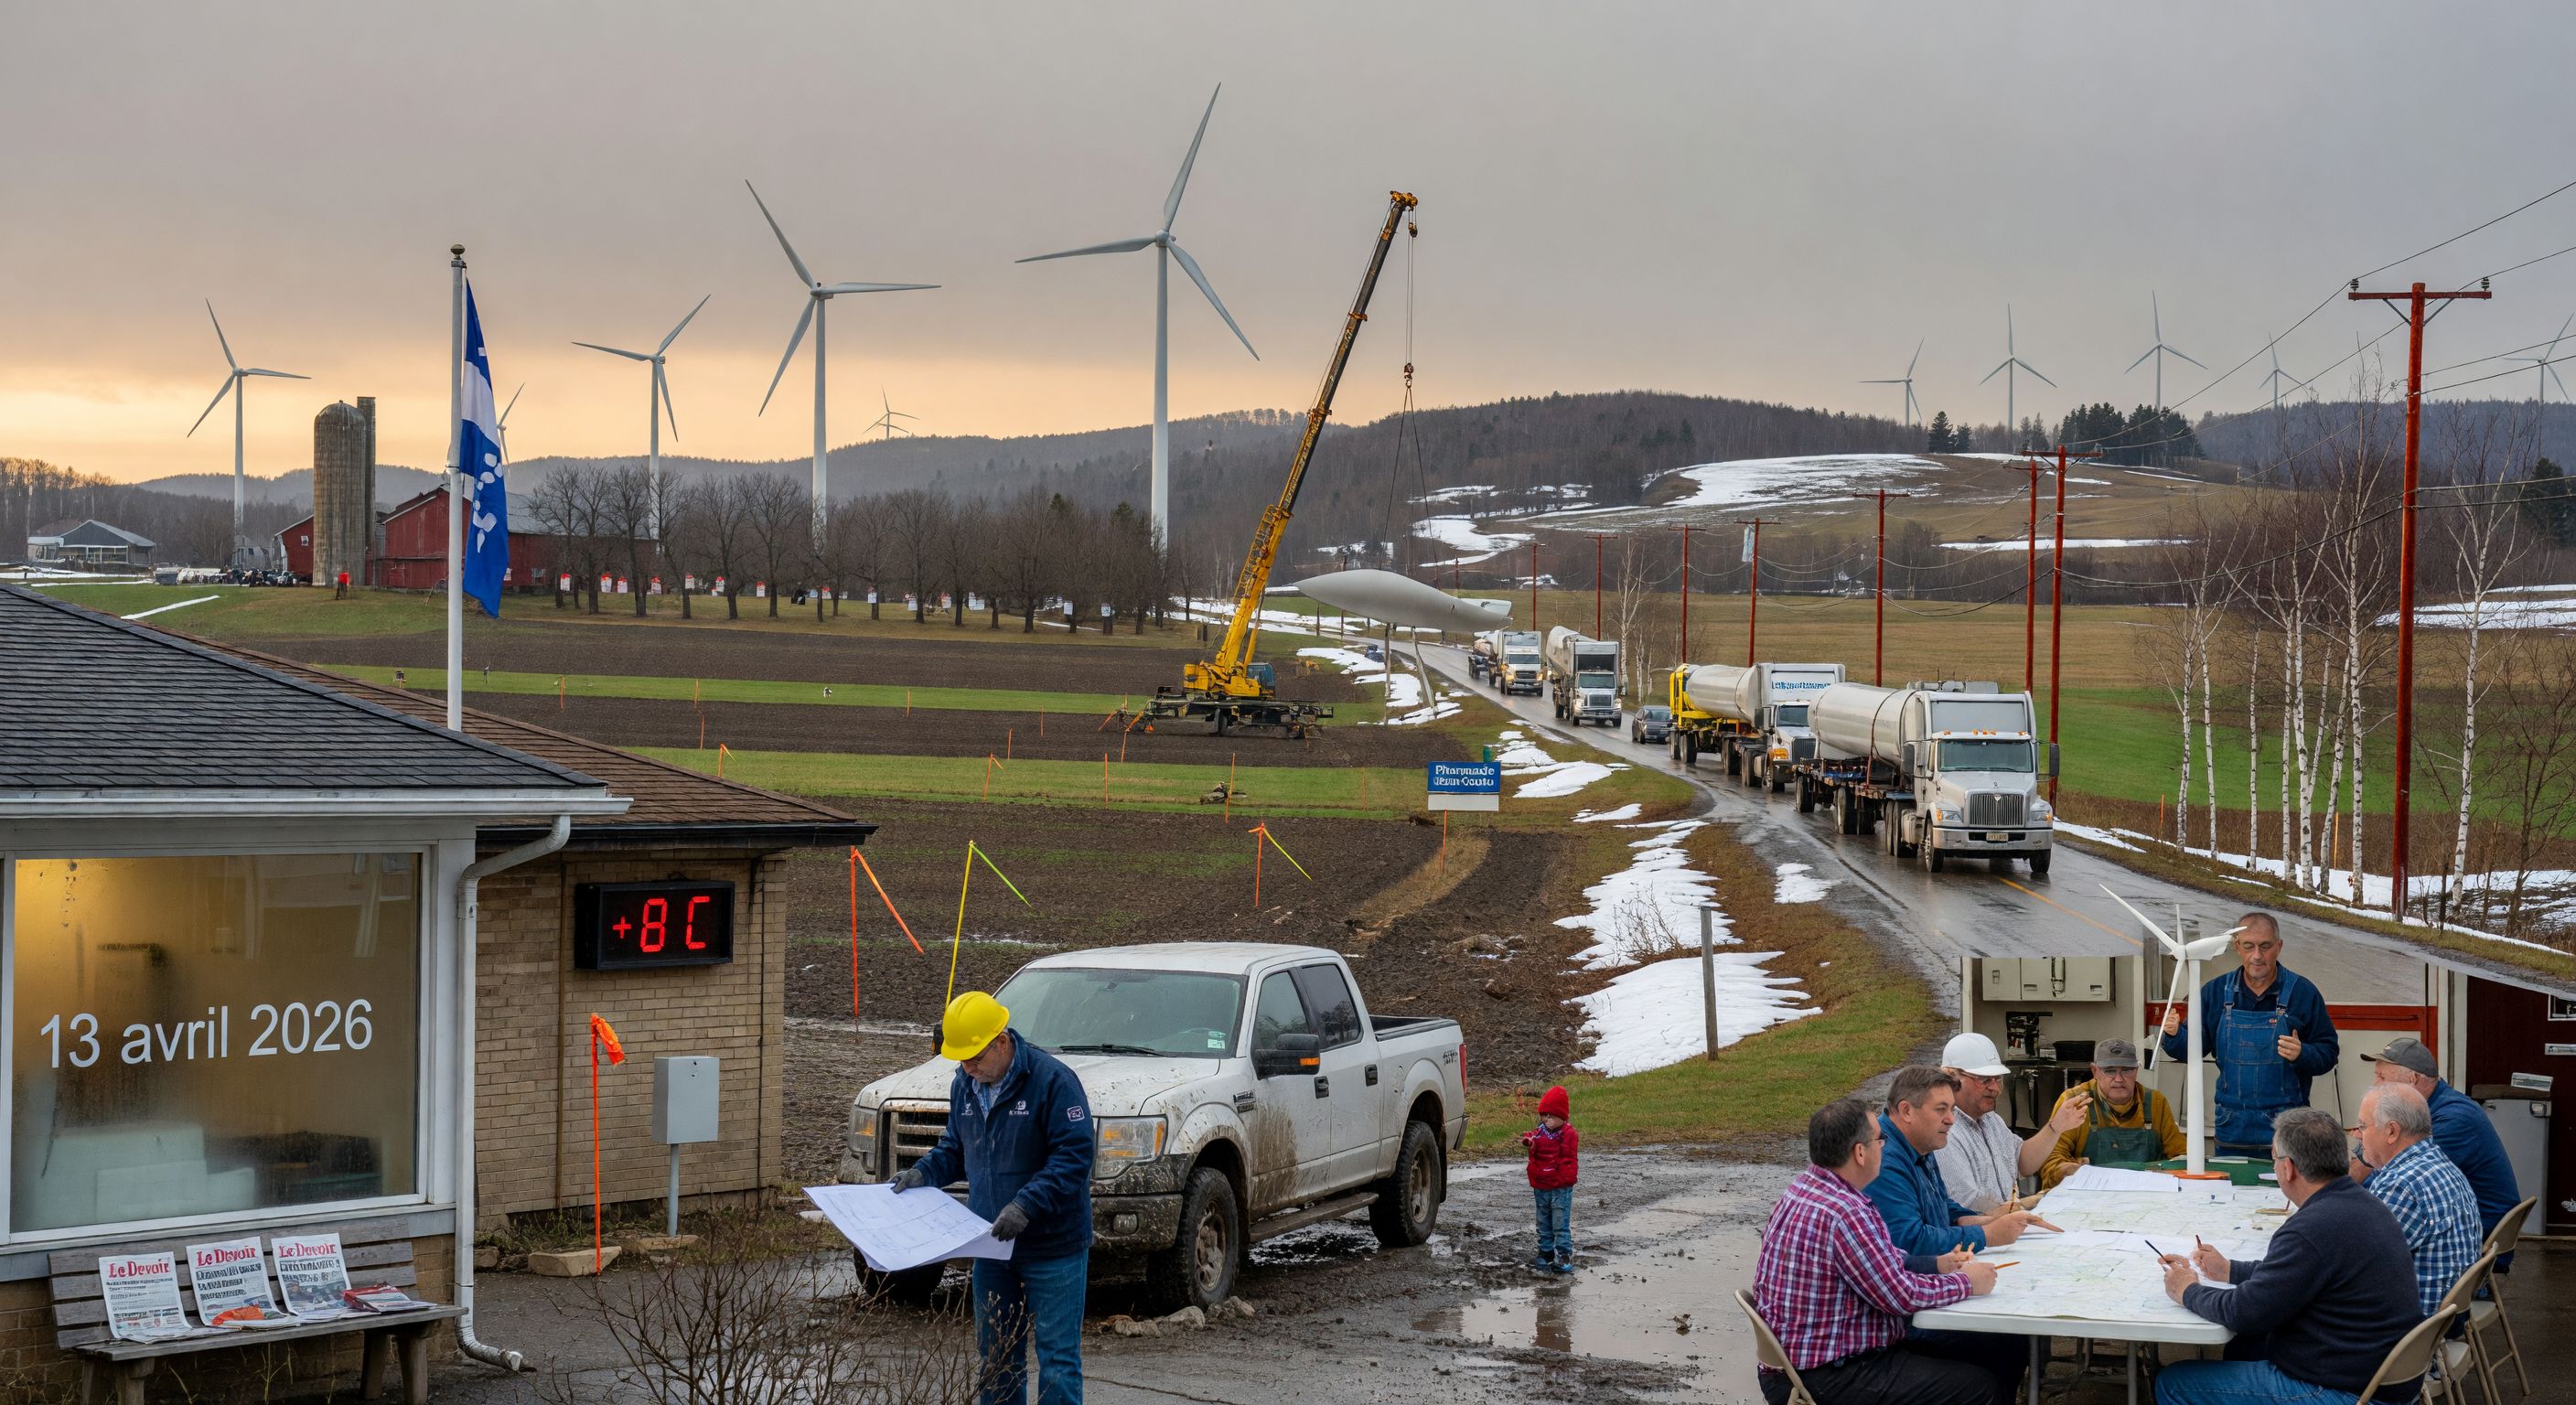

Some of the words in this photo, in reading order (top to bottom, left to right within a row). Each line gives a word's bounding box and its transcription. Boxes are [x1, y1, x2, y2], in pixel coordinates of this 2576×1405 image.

[40, 1013, 100, 1068] 13
[121, 1005, 229, 1064] avril
[248, 999, 373, 1057] 2026
[127, 1259, 170, 1277] Devoir
